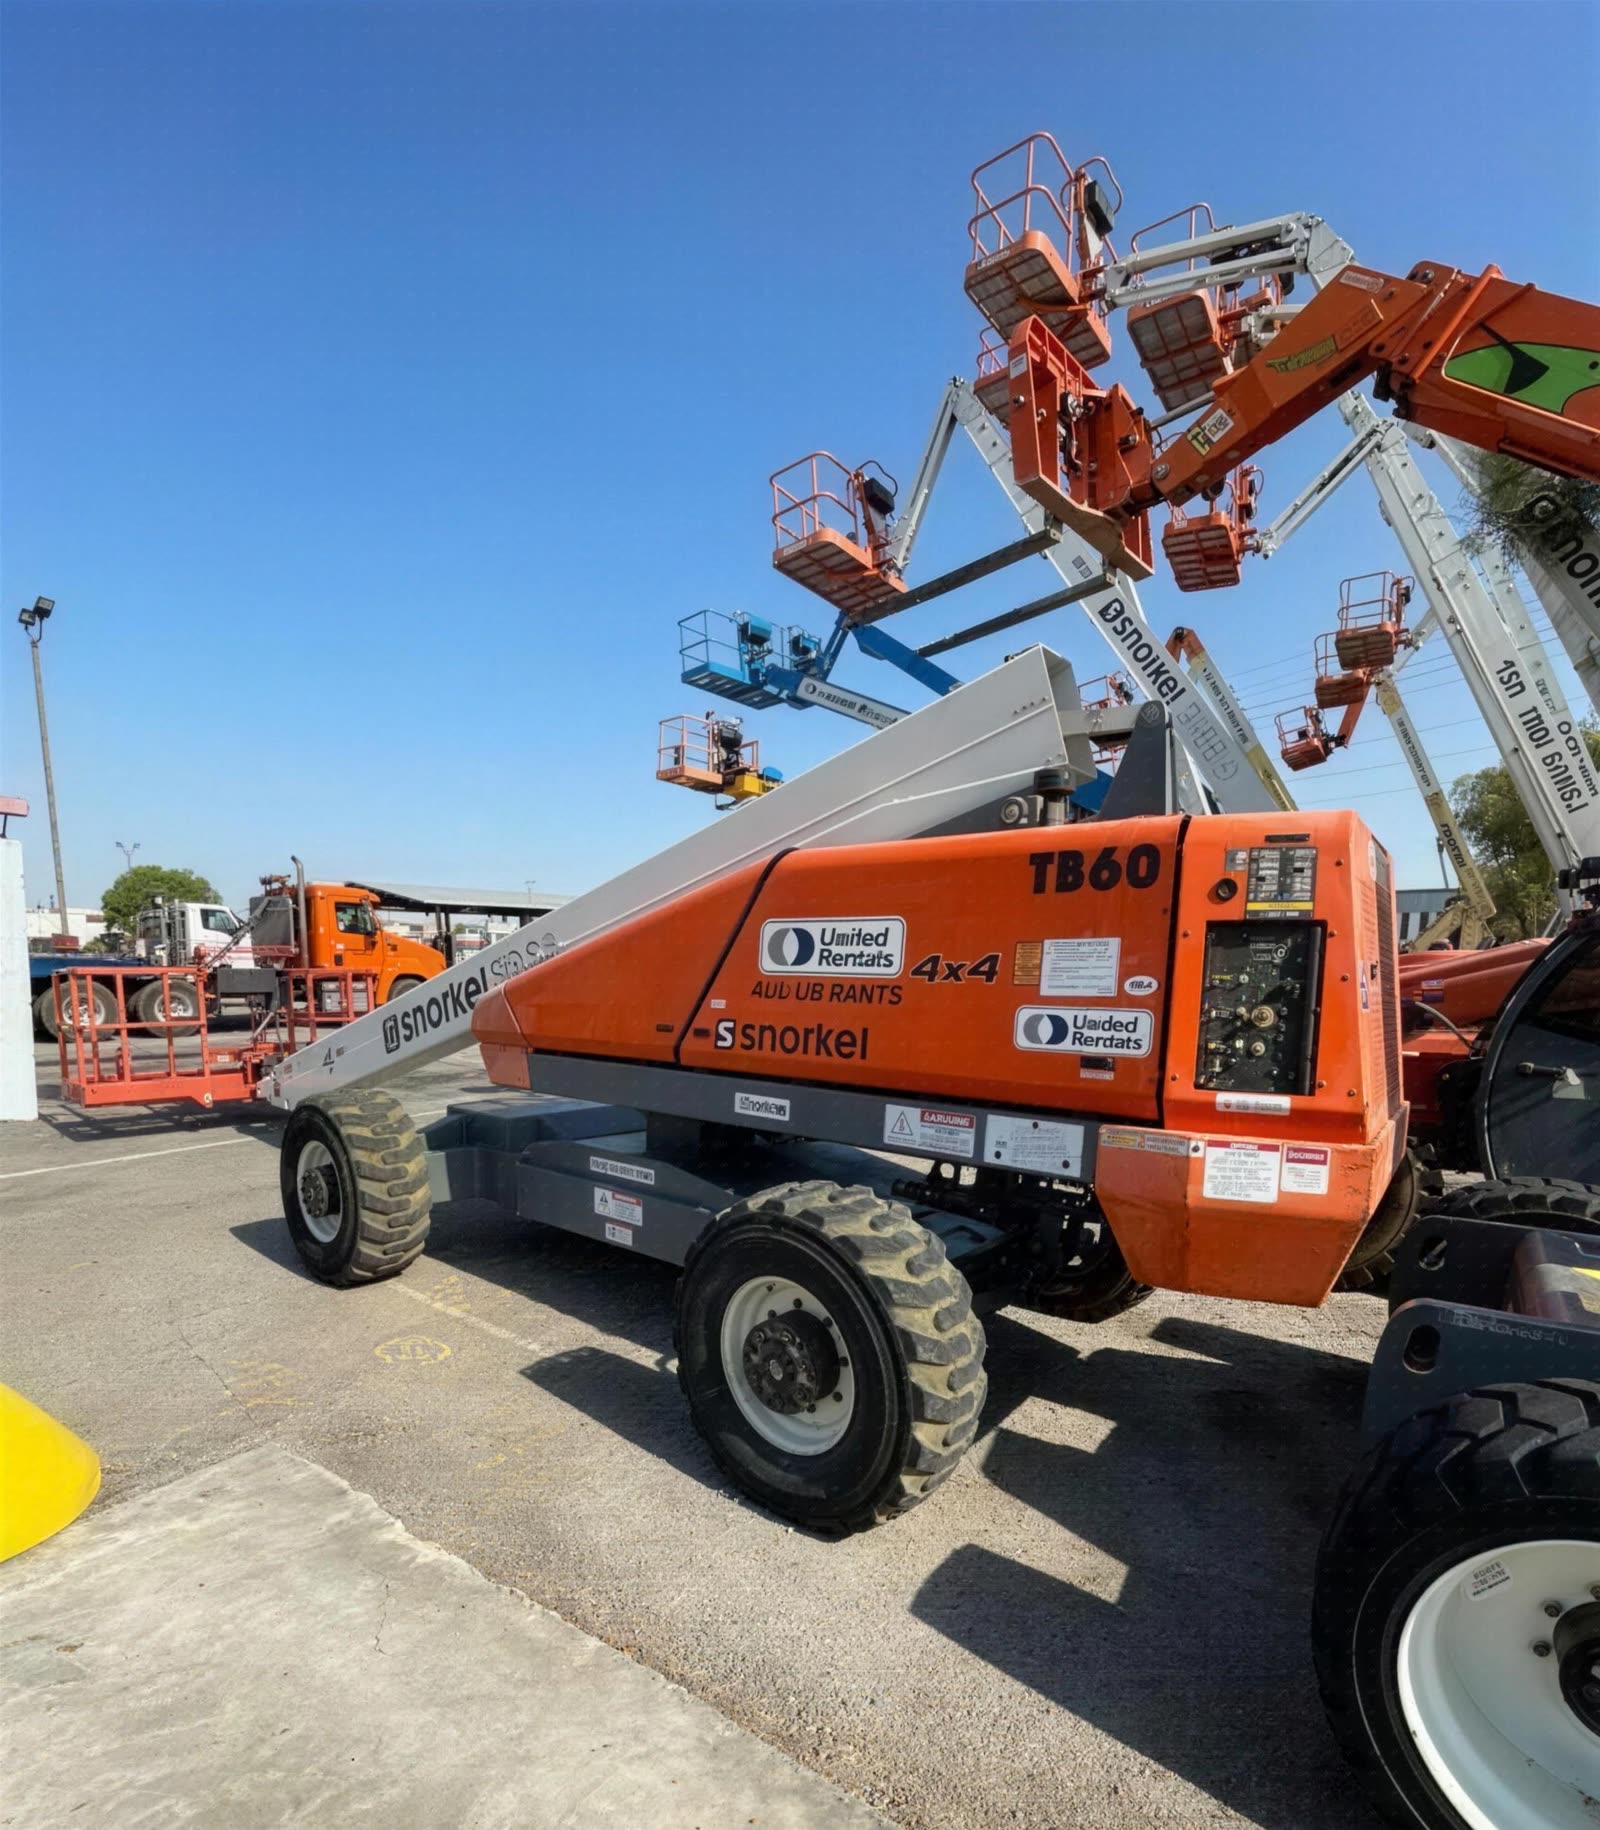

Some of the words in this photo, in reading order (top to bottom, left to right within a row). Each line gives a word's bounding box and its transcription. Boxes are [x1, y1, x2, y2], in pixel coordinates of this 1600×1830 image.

[1029, 843, 1161, 894] TB60
[910, 953, 1001, 984] 4x4
[740, 1023, 868, 1061] snorkel
